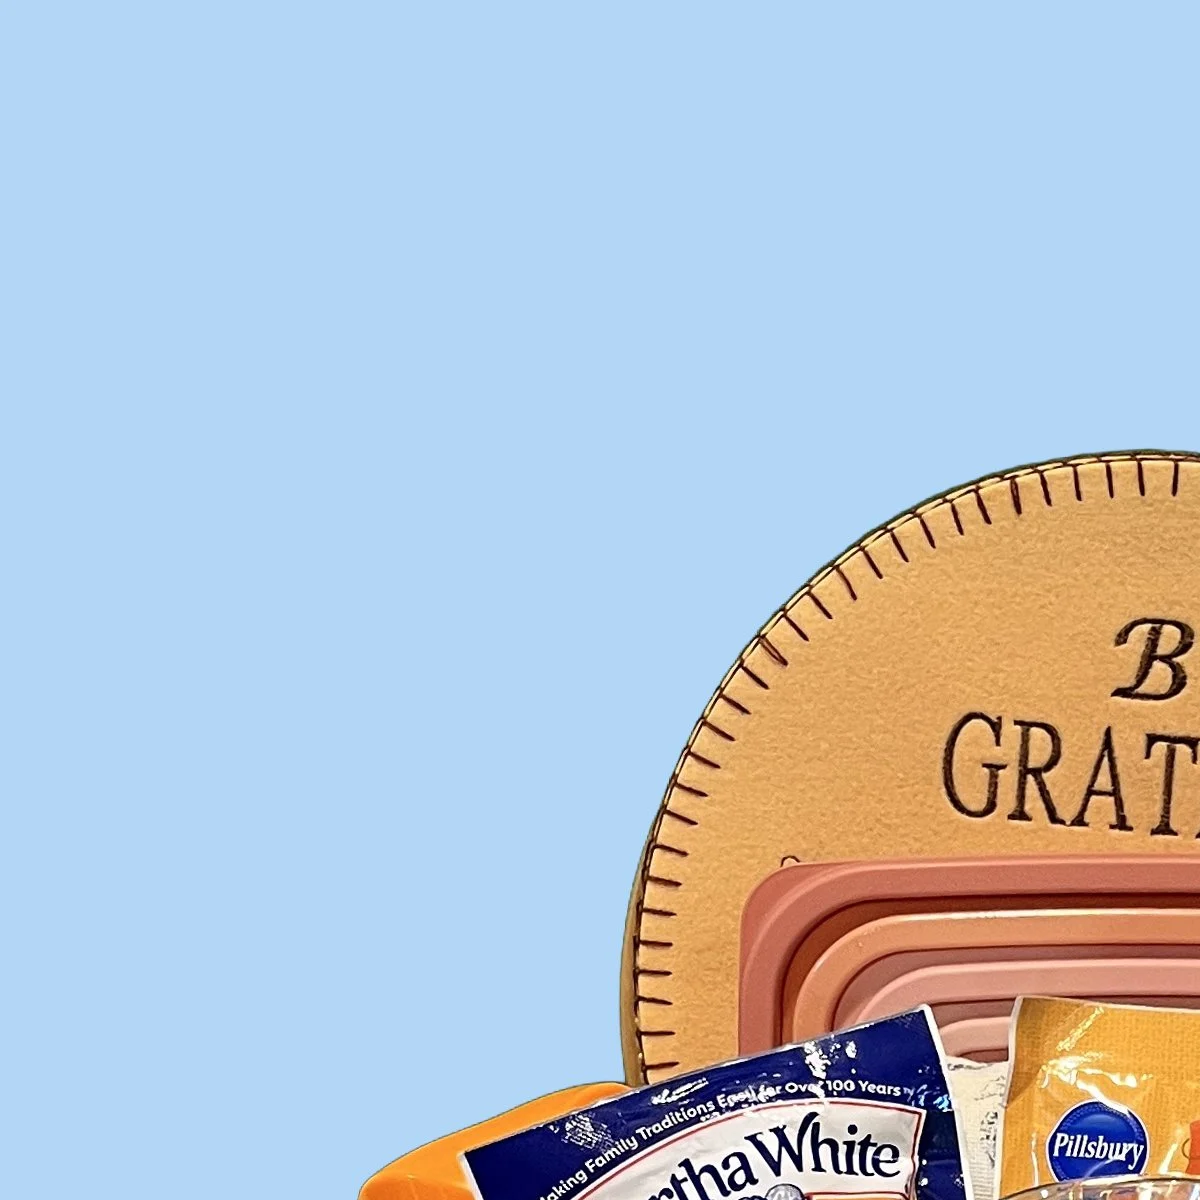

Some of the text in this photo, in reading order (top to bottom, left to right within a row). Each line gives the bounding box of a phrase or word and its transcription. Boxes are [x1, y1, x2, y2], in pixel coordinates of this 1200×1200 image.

[584, 1135, 639, 1173] Family
[635, 1100, 716, 1141] Traditions
[826, 1079, 855, 1092] 100
[744, 1111, 902, 1178] White
[1053, 1131, 1145, 1171] Pillsbury
